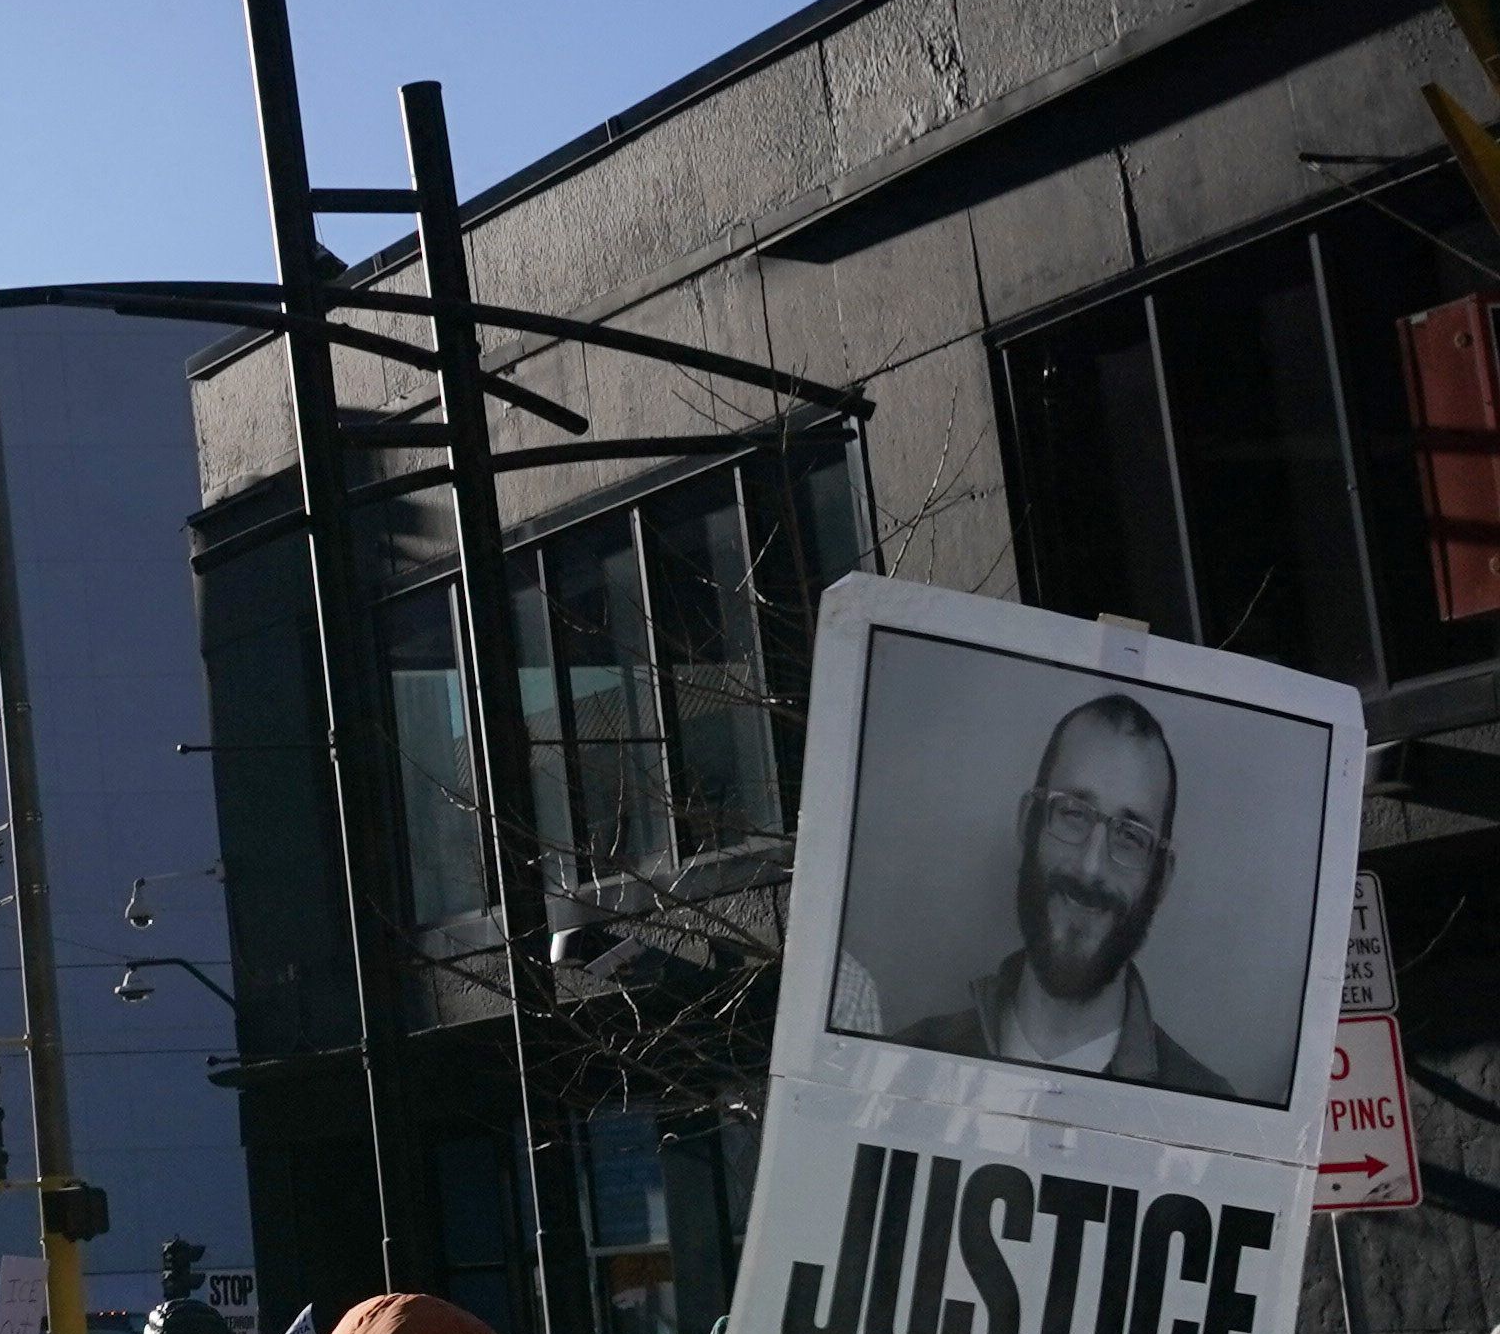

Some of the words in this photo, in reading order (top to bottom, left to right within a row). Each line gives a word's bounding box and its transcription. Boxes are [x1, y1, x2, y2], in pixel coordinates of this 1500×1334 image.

[1330, 1097, 1395, 1131] PING
[5, 1279, 42, 1304] ICE
[209, 1274, 253, 1307] STOP
